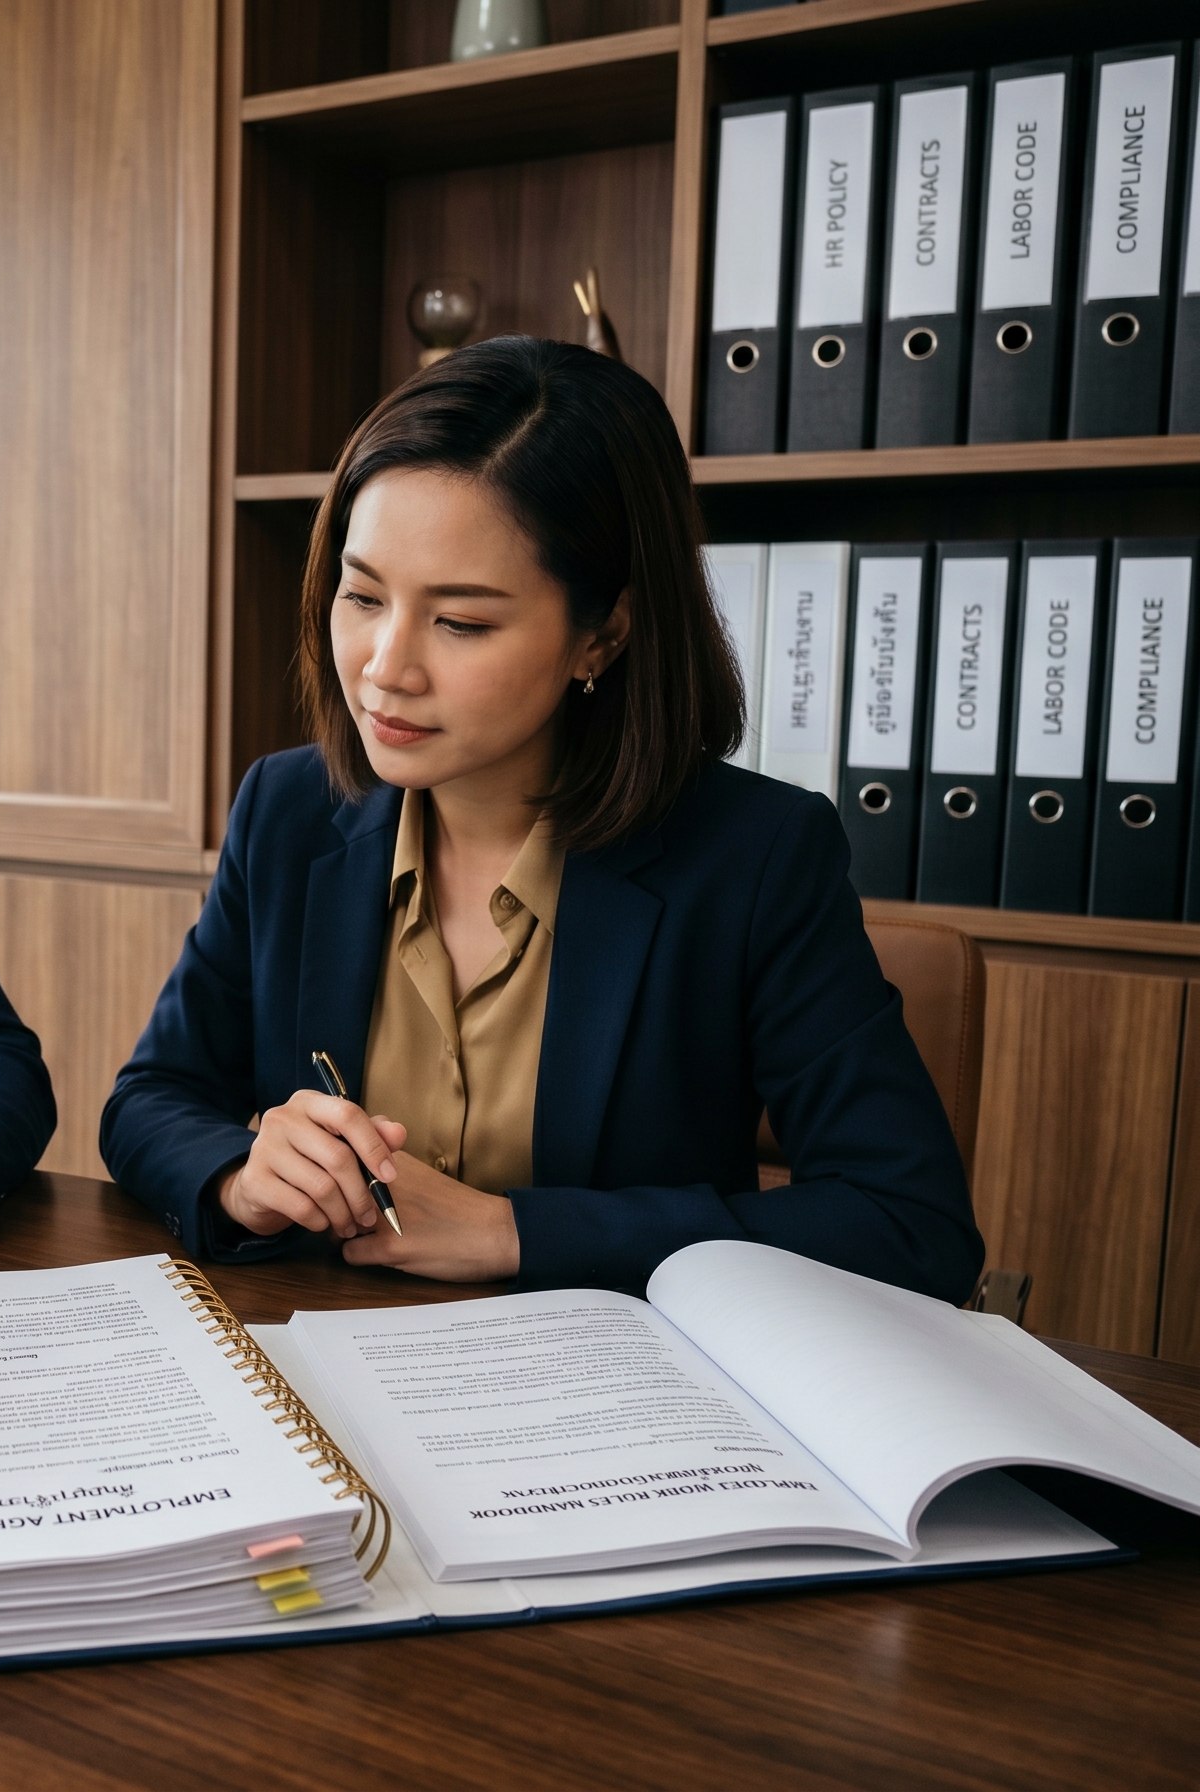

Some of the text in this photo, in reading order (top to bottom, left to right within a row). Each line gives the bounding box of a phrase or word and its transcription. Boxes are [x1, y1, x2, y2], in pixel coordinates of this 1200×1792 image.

[825, 159, 848, 268] HR POLICY
[915, 138, 941, 267] CONTRACTS
[1011, 120, 1038, 260] LABOR CODE
[1116, 104, 1146, 254] COMPLIANCE
[956, 603, 983, 731] CONTRACTS
[1043, 600, 1070, 736] LABOR CODE
[1134, 597, 1164, 745] COMPLIANCE
